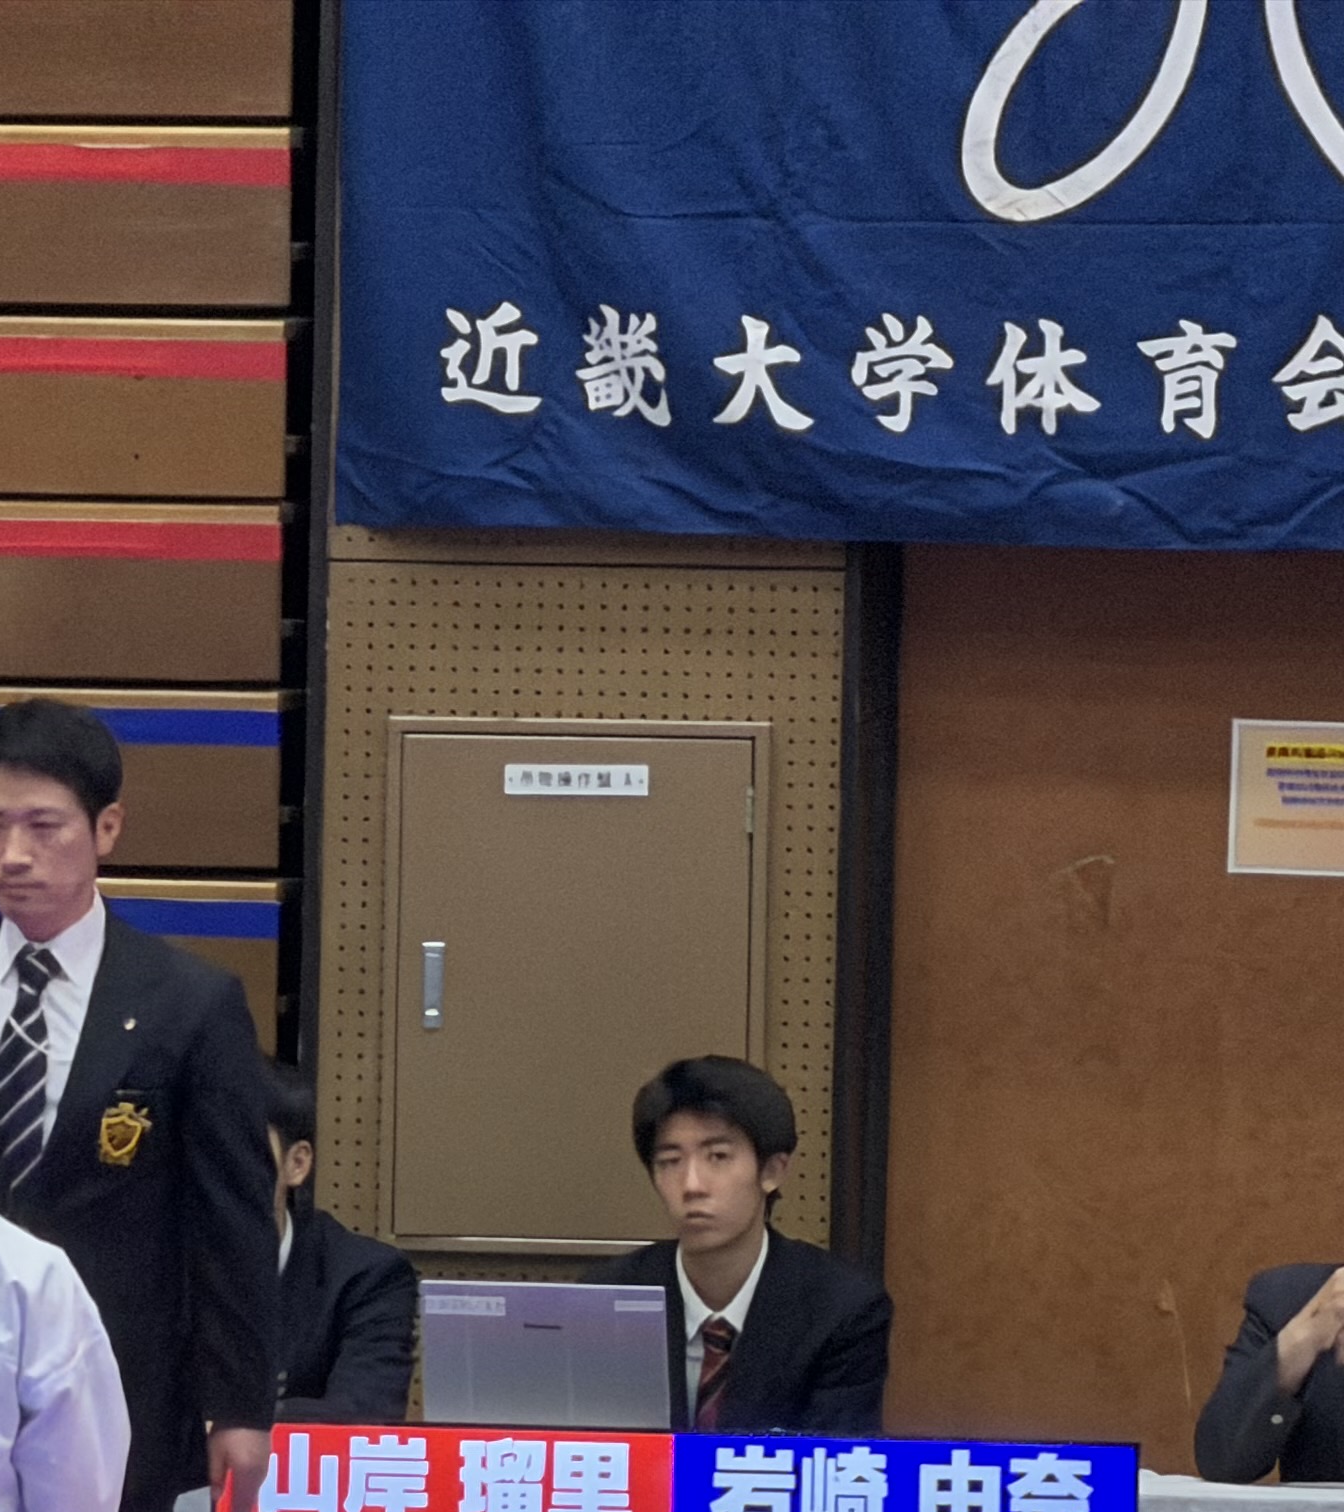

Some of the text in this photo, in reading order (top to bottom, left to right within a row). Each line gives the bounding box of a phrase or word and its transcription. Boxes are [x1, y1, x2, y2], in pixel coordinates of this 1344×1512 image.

[441, 301, 1344, 439] 近畿大学体育会
